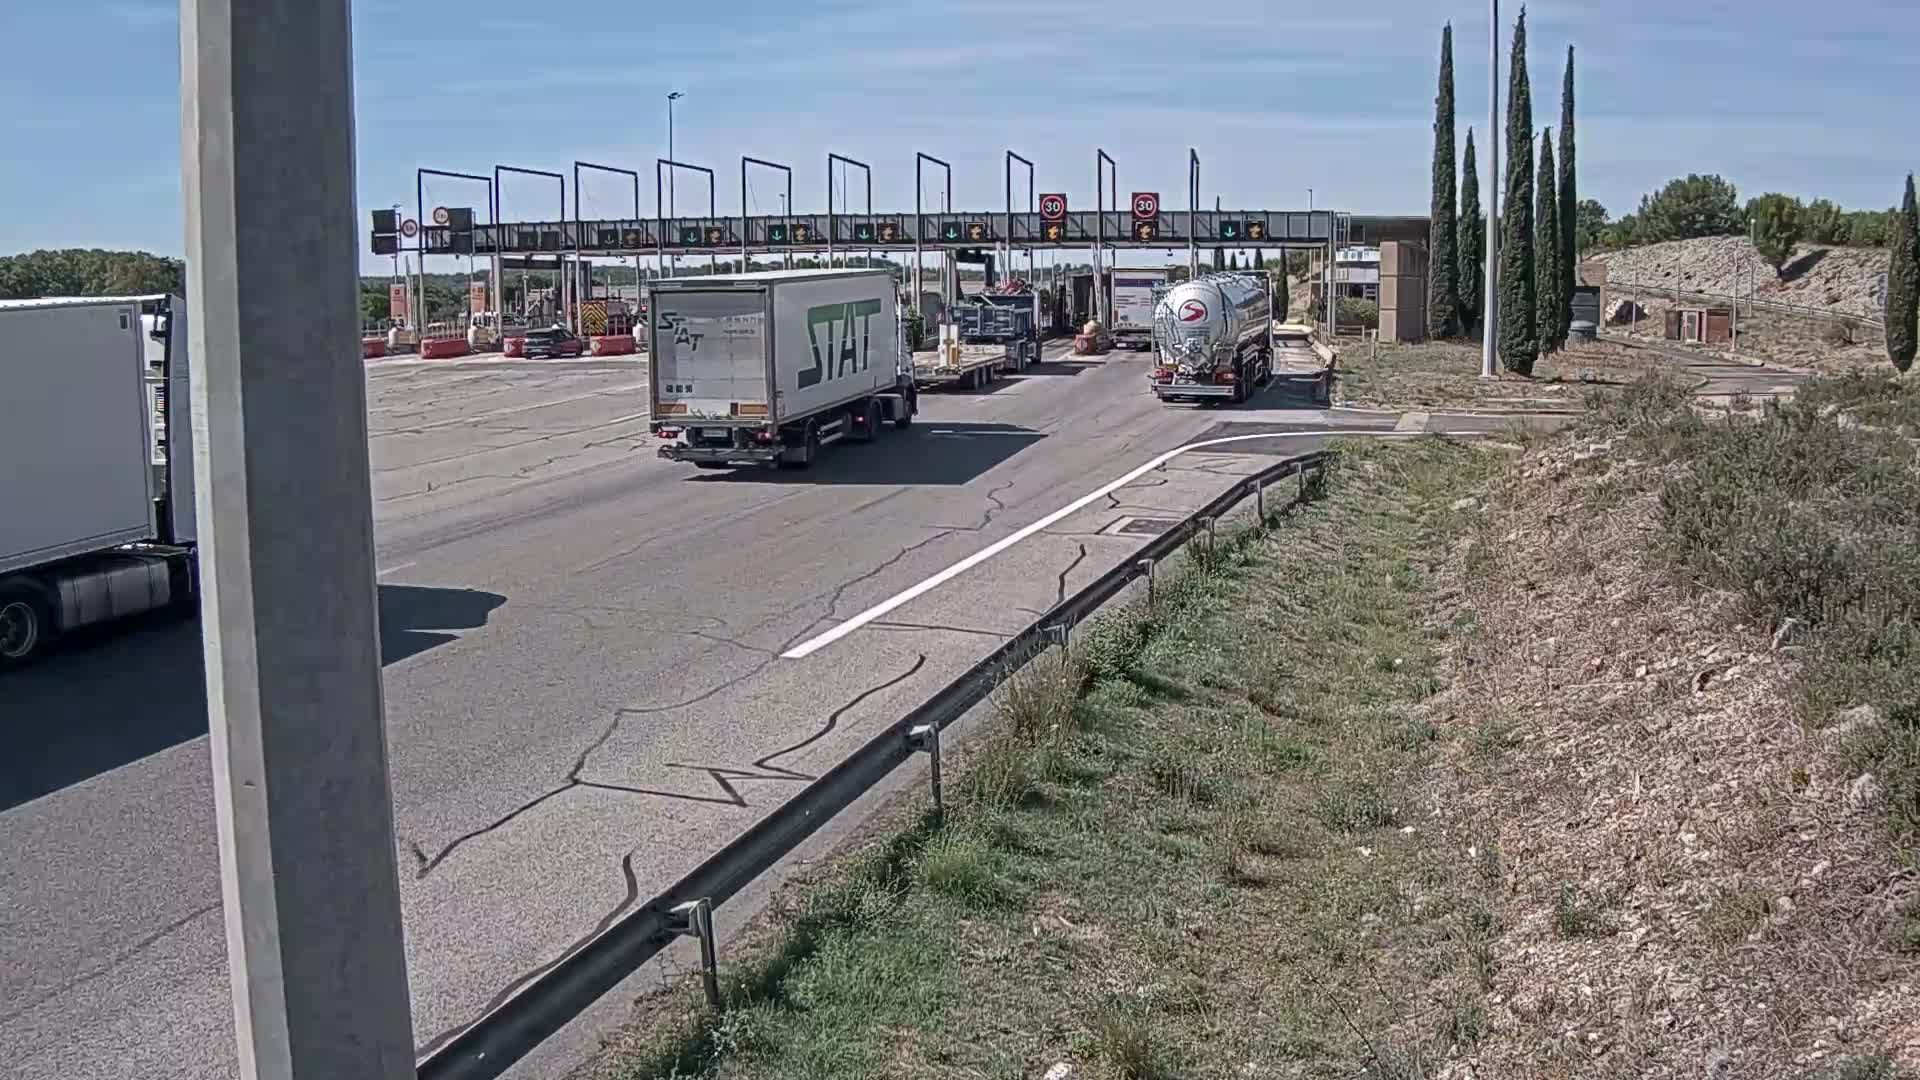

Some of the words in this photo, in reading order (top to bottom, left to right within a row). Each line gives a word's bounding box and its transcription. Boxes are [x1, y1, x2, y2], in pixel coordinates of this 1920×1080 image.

[1045, 201, 1061, 213] 30
[1137, 200, 1153, 211] 30
[658, 312, 704, 351] STAT
[798, 298, 881, 390] STAT
